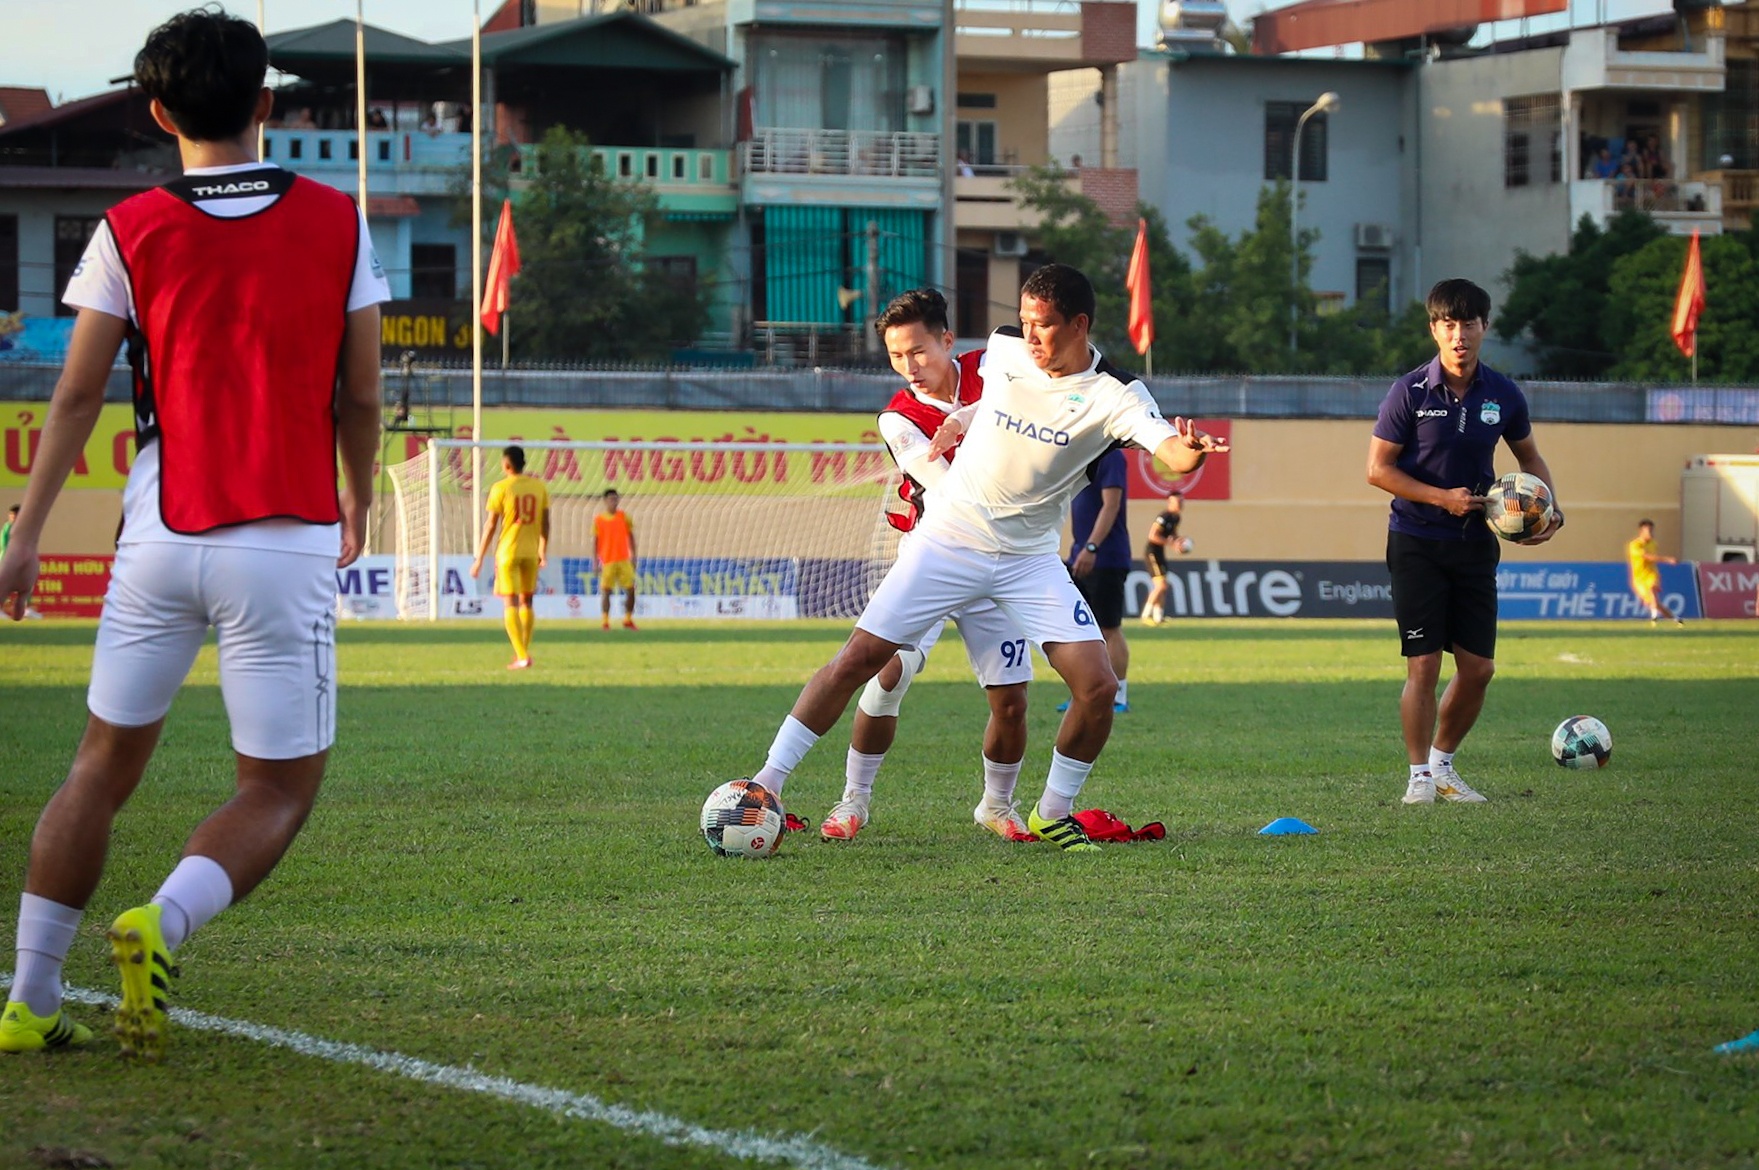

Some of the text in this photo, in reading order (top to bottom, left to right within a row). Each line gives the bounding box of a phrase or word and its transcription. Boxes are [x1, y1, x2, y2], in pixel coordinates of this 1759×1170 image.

[192, 180, 269, 196] THACO
[994, 410, 1070, 446] THACO
[514, 493, 536, 524] 19
[1124, 560, 1301, 616] mitre
[1001, 639, 1026, 668] 97
